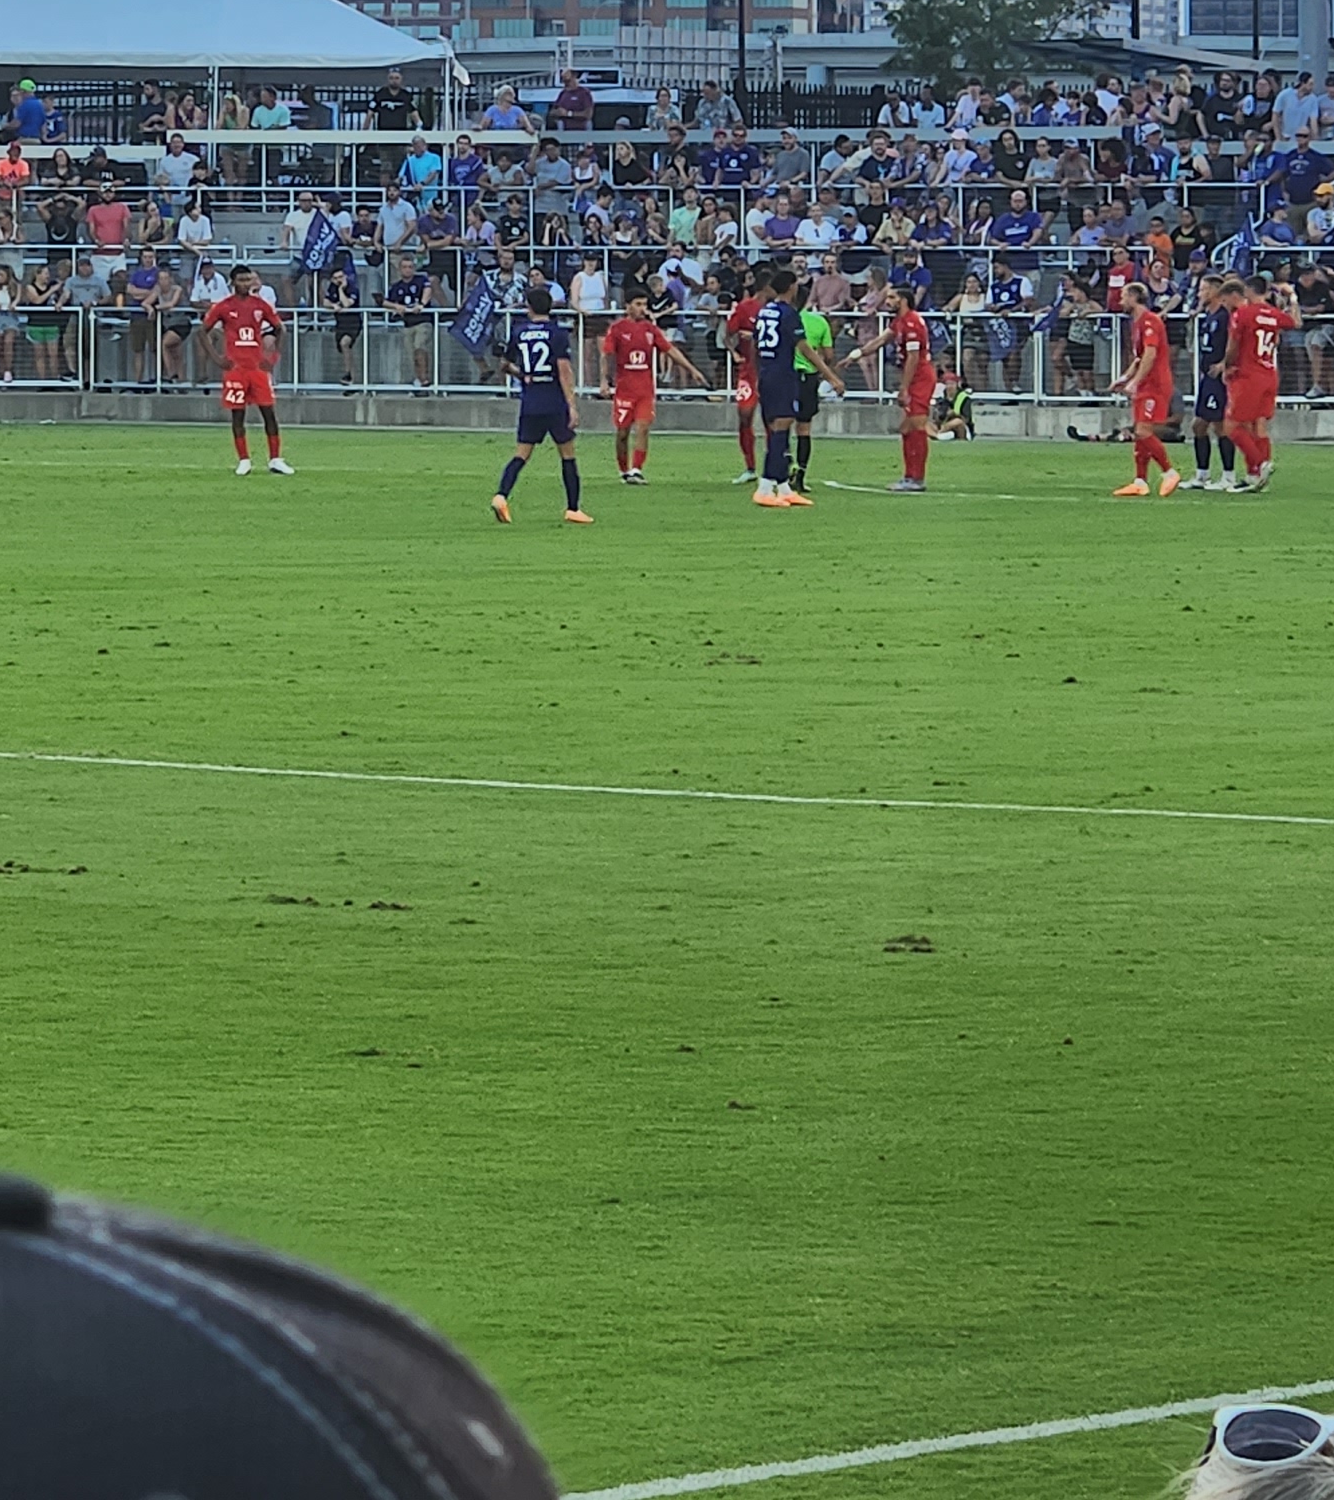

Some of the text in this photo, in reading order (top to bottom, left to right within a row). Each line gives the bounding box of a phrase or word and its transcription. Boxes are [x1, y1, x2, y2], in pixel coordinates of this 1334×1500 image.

[755, 319, 780, 349] 23
[517, 341, 552, 373] 12
[225, 389, 245, 404] 42
[1206, 395, 1218, 410] 4
[618, 408, 628, 423] 7
